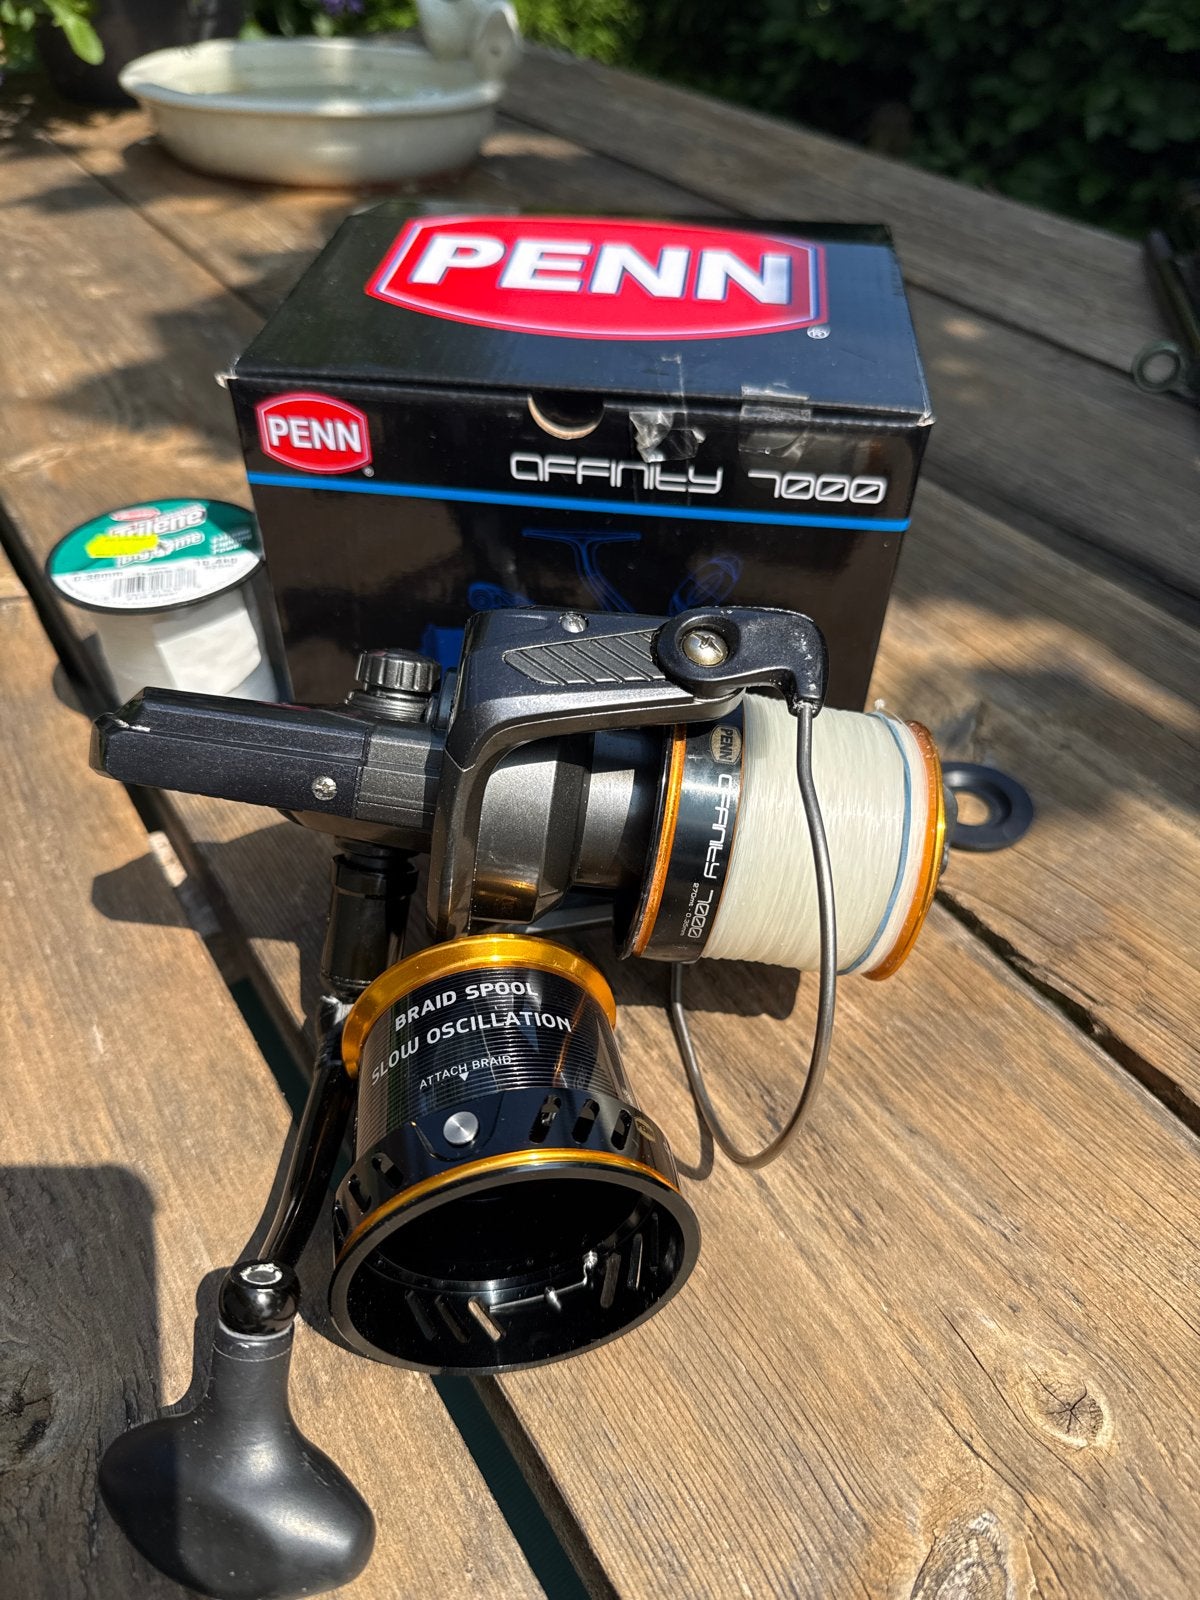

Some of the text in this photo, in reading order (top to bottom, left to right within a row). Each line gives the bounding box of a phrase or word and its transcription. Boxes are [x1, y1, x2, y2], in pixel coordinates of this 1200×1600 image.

[409, 236, 793, 305] PENN
[267, 416, 363, 453] PENN
[748, 469, 887, 504] 7000
[718, 727, 734, 761] PENN
[688, 889, 714, 939] 7000
[395, 981, 539, 1031] BRAID SPOOL
[371, 1011, 572, 1086] SLOW OSCILLATION
[419, 1055, 512, 1090] ATTACH BRAID
